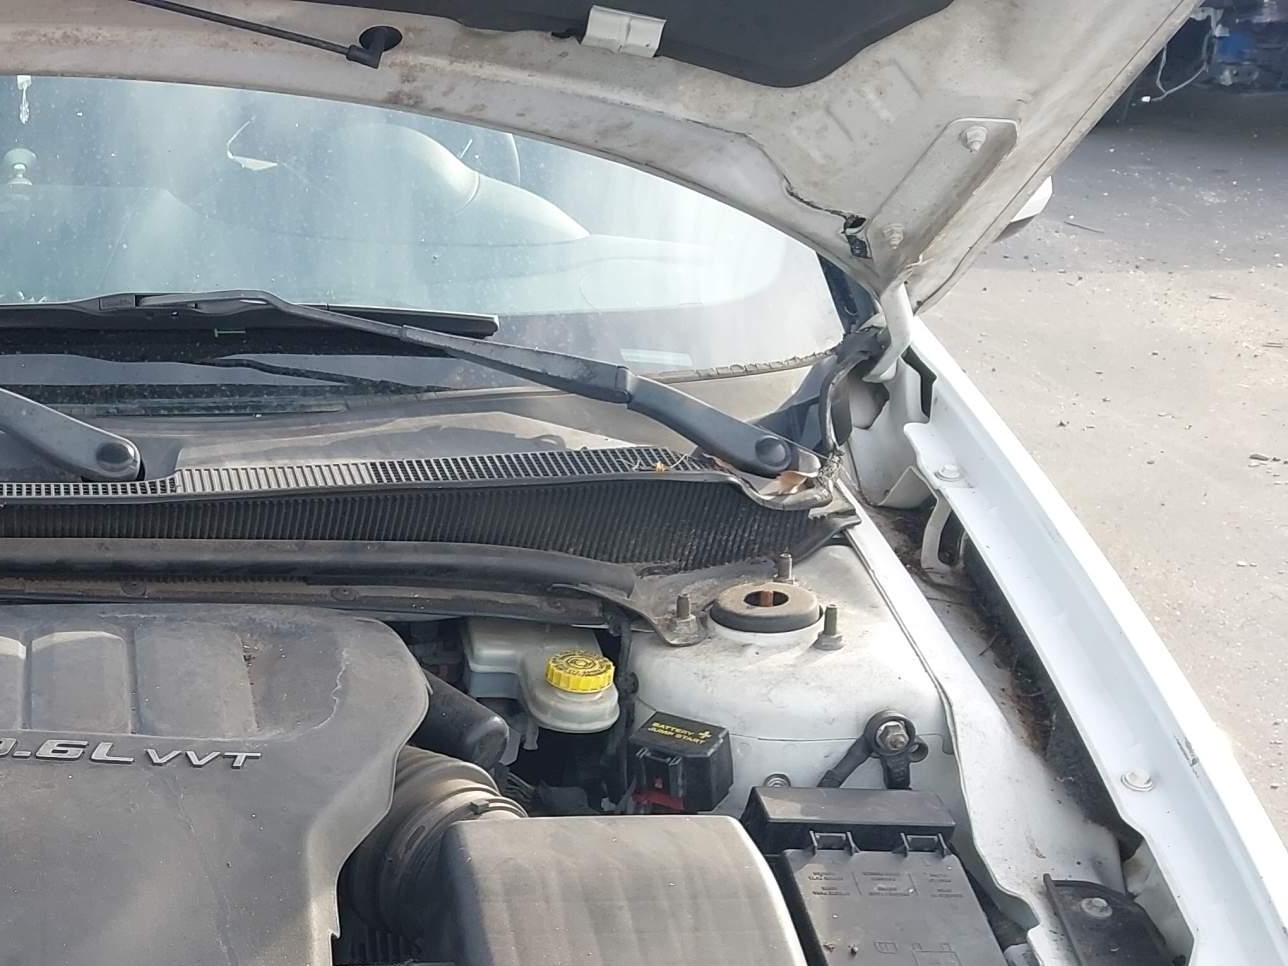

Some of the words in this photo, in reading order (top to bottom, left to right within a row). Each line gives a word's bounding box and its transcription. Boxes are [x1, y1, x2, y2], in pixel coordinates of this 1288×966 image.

[652, 722, 695, 736] BATTERY
[675, 733, 706, 744] START
[144, 748, 262, 769] VVT
